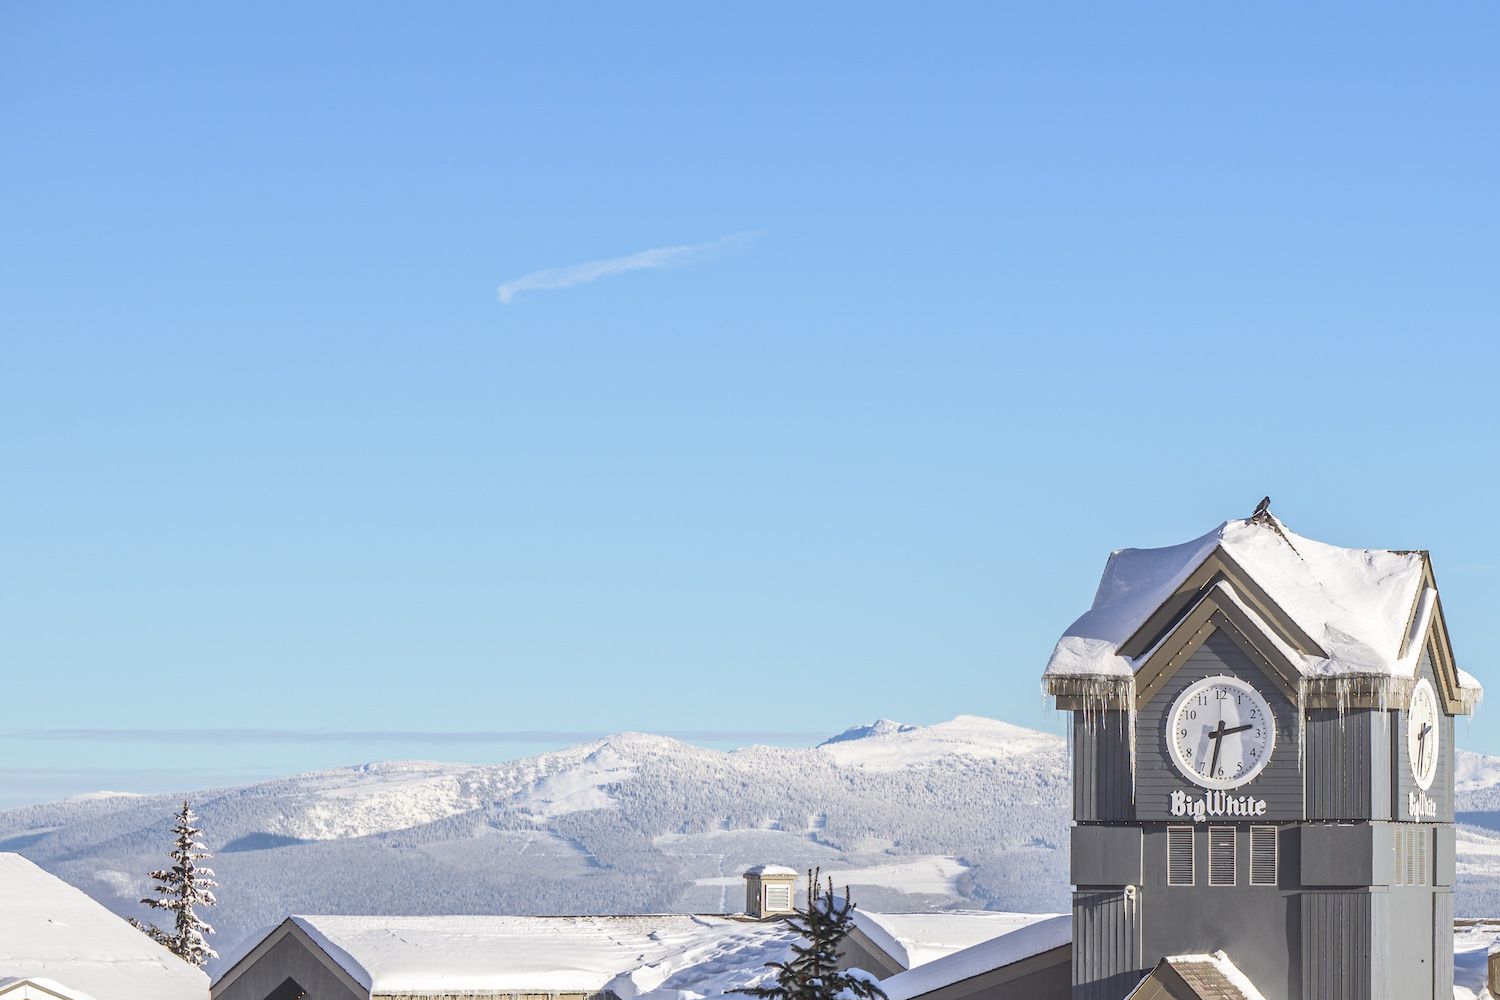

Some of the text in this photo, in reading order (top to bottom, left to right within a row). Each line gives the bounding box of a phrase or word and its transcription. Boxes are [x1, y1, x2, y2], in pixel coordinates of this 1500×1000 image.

[1216, 689, 1227, 700] 12
[1198, 696, 1207, 706] 11
[1185, 710, 1197, 720] 10
[1250, 709, 1256, 719] 2
[1181, 728, 1188, 738] 9
[1255, 729, 1261, 738] 3
[1186, 748, 1192, 757] 8
[1250, 748, 1257, 757] 4
[1200, 762, 1206, 772] 7
[1218, 767, 1224, 776] 6
[1237, 762, 1243, 771] 5
